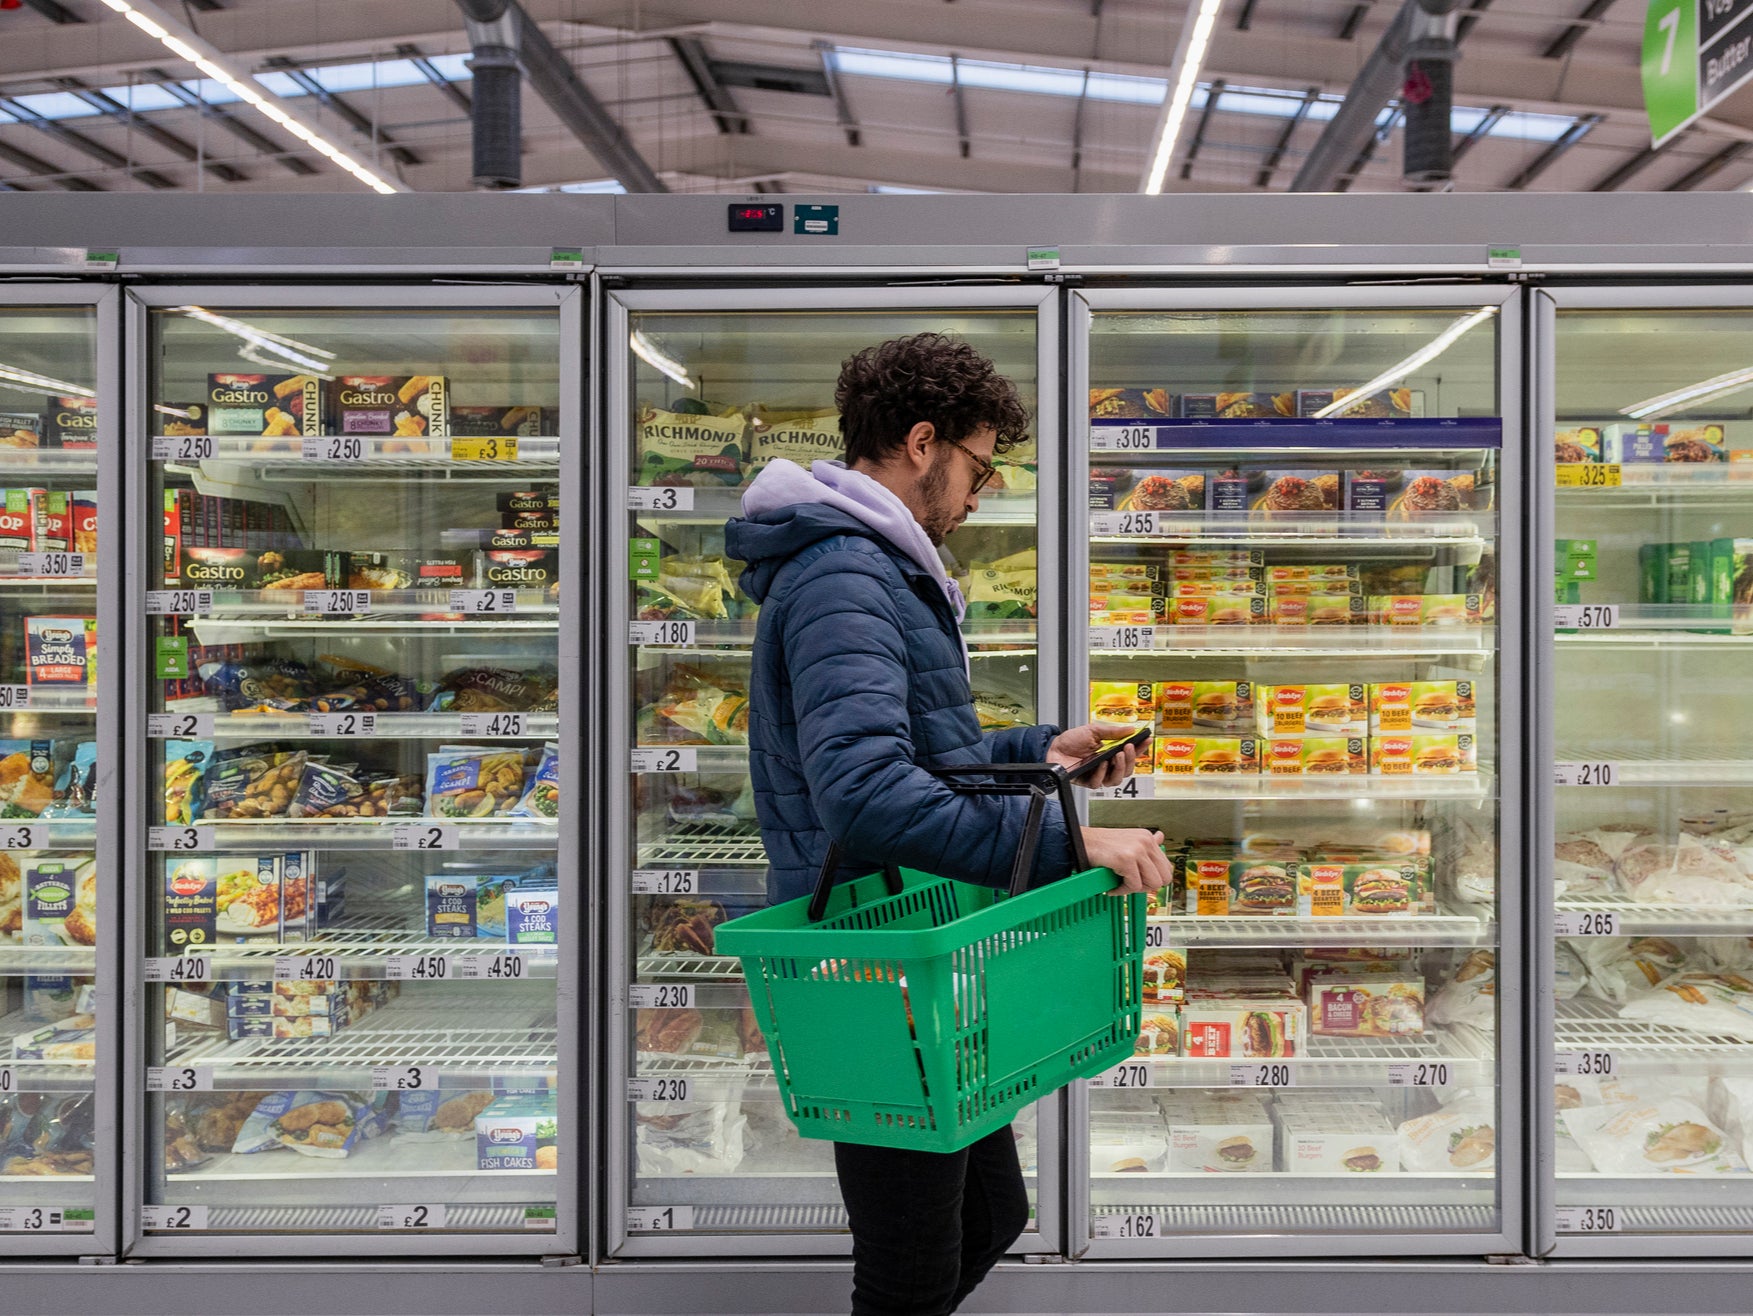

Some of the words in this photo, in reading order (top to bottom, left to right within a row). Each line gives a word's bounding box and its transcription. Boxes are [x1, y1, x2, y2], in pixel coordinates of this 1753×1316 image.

[1659, 6, 1680, 76] 7
[1706, 35, 1751, 86] Butter
[211, 388, 269, 403] Gastro
[340, 390, 396, 405] Gastro
[305, 381, 317, 436] CHUNK
[431, 381, 442, 436] CHUNK
[528, 411, 539, 436] CHU
[644, 424, 736, 443] RICHMOND
[178, 438, 212, 458] £2.50
[1117, 428, 1150, 448] £3.05
[328, 439, 361, 459] £2.50
[479, 439, 498, 459] £3
[1580, 465, 1606, 486] £3.25
[509, 499, 543, 508] Gastro
[652, 488, 677, 509] £3
[83, 517, 96, 531] C
[514, 519, 549, 528] Gastro
[1119, 513, 1153, 533] £2.55
[491, 536, 527, 546] Gastro
[41, 554, 67, 574] £3.50
[186, 563, 245, 580] Gastro
[488, 566, 547, 581] Gastro
[170, 592, 196, 612] £2.50
[327, 592, 354, 611] £2.50
[476, 591, 496, 611] £2
[1578, 607, 1612, 627] £5.70
[654, 622, 688, 643] £1.80
[1112, 628, 1138, 648] £1.85
[31, 655, 86, 665] BREADED
[41, 644, 75, 656] Simply
[40, 668, 46, 678] 4
[173, 715, 198, 735] £2
[337, 715, 355, 735] £2
[486, 715, 520, 736] £4.25
[1276, 712, 1284, 720] 10
[656, 750, 680, 771] £2
[1578, 765, 1611, 785] £2.10
[1114, 777, 1138, 798] £4
[8, 827, 32, 848] £3
[174, 828, 198, 849] £3
[418, 828, 443, 849] £2
[658, 872, 692, 893] £1.25
[37, 901, 68, 910] FILLETS
[437, 905, 467, 913] STEAKS
[519, 922, 552, 932] STEAKS
[524, 915, 529, 923] 4
[530, 915, 546, 923] COD
[1579, 914, 1613, 935] £2.65
[170, 958, 204, 979] £4.20
[301, 958, 334, 979] £4.20
[411, 957, 445, 978] £4.50
[488, 956, 521, 978] £4.50
[654, 986, 688, 1007] £2.30
[1336, 994, 1344, 1002] 4
[1327, 1003, 1352, 1011] BACON
[1193, 1036, 1203, 1045] 4
[1208, 1025, 1216, 1056] BEEF
[1578, 1053, 1612, 1074] £3.50
[0, 1070, 10, 1091] 0
[172, 1068, 197, 1089] £3
[397, 1067, 422, 1089] £3
[1114, 1066, 1147, 1086] £2.70
[1255, 1065, 1289, 1085] £2.80
[1413, 1064, 1447, 1085] £2.70
[653, 1080, 687, 1101] £2.30
[481, 1157, 500, 1168] FISH
[503, 1157, 533, 1168] CAKES
[24, 1209, 42, 1229] £3
[166, 1207, 191, 1228] £2
[404, 1205, 428, 1228] £2
[652, 1207, 673, 1229] £1
[1120, 1216, 1154, 1237] £1.62
[1581, 1209, 1615, 1230] £3.50
